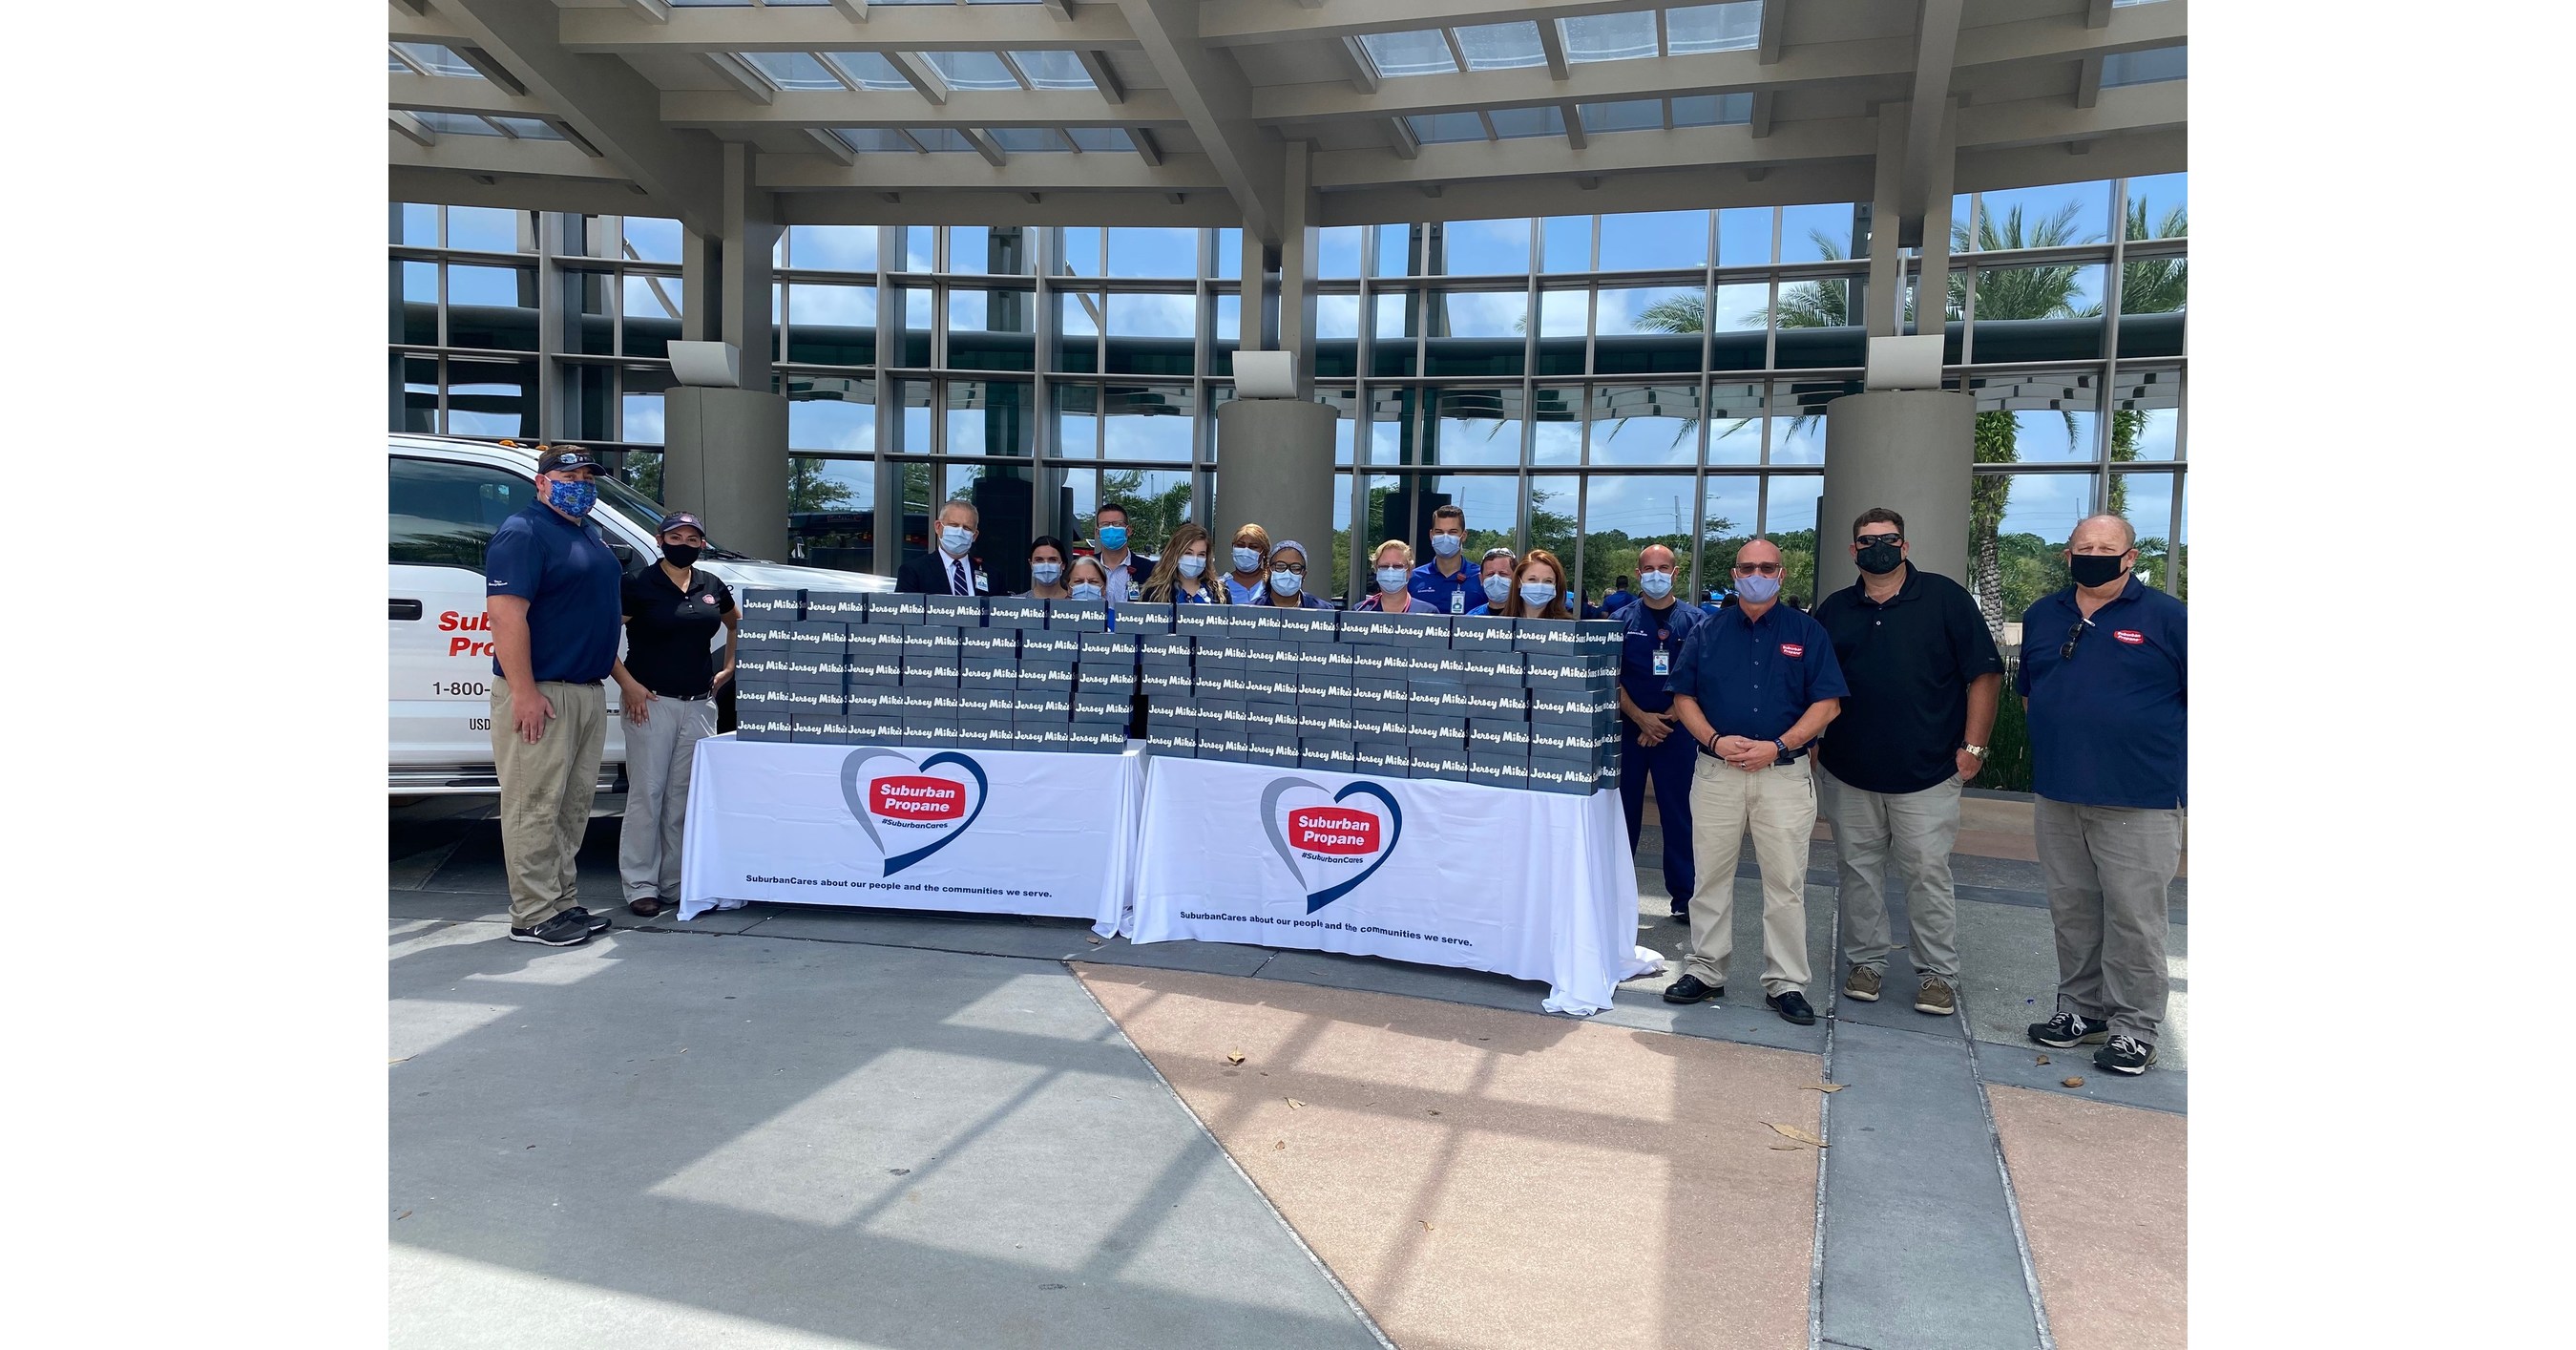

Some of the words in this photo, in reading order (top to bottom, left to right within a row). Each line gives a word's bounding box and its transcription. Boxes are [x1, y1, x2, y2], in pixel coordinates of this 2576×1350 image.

[743, 599, 771, 611] Jersey
[807, 601, 836, 614] Jersey
[869, 603, 898, 615] Jersey
[927, 605, 954, 617] Jersey
[990, 607, 1018, 620] Jersey
[1051, 610, 1079, 622] Jersey
[1115, 613, 1143, 625] Jersey
[1177, 615, 1204, 626] Jersey
[1229, 617, 1256, 629] Jersey
[1282, 619, 1309, 632] Jersey
[1310, 621, 1335, 631] Mike's
[1341, 622, 1369, 635] Jersey
[1394, 624, 1423, 638] Jersey
[1454, 627, 1484, 641] Jersey
[1486, 628, 1513, 640] Mike's
[737, 629, 766, 642] Jersey
[791, 631, 820, 643] Jersey
[848, 633, 876, 645] Jersey
[904, 635, 932, 647] Jersey
[1517, 629, 1546, 643] Jersey
[962, 637, 991, 649] Jersey
[1023, 639, 1053, 651] Jersey
[1081, 643, 1110, 655] Jersey
[1141, 643, 1166, 656] Jersey
[1168, 645, 1190, 655] Mike's
[1197, 646, 1223, 659] Jersey
[1247, 649, 1274, 663] Jersey
[1299, 652, 1327, 665] Jersey
[736, 660, 764, 672] Jersey
[789, 662, 817, 674] Jersey
[819, 663, 844, 673] Mike's
[1353, 655, 1382, 668] Jersey
[1409, 658, 1438, 672] Jersey
[848, 664, 874, 676] Jersey
[875, 664, 900, 675] Mike's
[904, 665, 932, 678] Jersey
[962, 667, 991, 680] Jersey
[1018, 669, 1046, 682] Jersey
[1464, 662, 1494, 676] Jersey
[1497, 664, 1523, 675] Mike's
[1527, 664, 1559, 679] Jersey
[1560, 666, 1587, 678] Mike's
[1079, 673, 1108, 686] Jersey
[1142, 674, 1167, 686] Jersey
[1169, 676, 1192, 686] Mike's
[1196, 677, 1222, 690] Jersey
[1246, 681, 1272, 694] Jersey
[1273, 683, 1297, 693] Mike's
[1299, 684, 1326, 697] Jersey
[1353, 687, 1381, 701] Jersey
[736, 690, 765, 703] Jersey
[789, 692, 817, 706] Jersey
[819, 694, 844, 704] Mike's
[848, 694, 877, 707] Jersey
[904, 696, 932, 708] Jersey
[1410, 692, 1440, 706] Jersey
[1468, 695, 1497, 709] Jersey
[1498, 698, 1526, 709] Mike's
[958, 698, 987, 710] Jersey
[1015, 700, 1043, 712] Jersey
[1076, 703, 1104, 715] Jersey
[1533, 700, 1564, 714] Jersey
[1148, 705, 1173, 717] Jersey
[1175, 707, 1197, 716] Mike's
[1197, 707, 1223, 721] Jersey
[1224, 710, 1246, 721] Mike's
[1247, 712, 1273, 726] Jersey
[1299, 716, 1327, 729] Jersey
[1328, 718, 1351, 728] Mike's
[738, 721, 765, 732] Jersey
[793, 723, 822, 735] Jersey
[848, 725, 876, 737] Jersey
[903, 727, 932, 739] Jersey
[1352, 720, 1380, 734] Jersey
[1408, 725, 1437, 739] Jersey
[959, 728, 988, 741] Jersey
[1015, 730, 1043, 743] Jersey
[1070, 732, 1099, 745] Jersey
[1471, 729, 1500, 744] Jersey
[1147, 735, 1172, 748] Jersey
[1173, 737, 1196, 747] Mike's
[1199, 739, 1224, 751] Jersey
[1225, 741, 1247, 751] Mike's
[1532, 734, 1563, 749] Jersey
[1248, 743, 1274, 756] Jersey
[1275, 746, 1299, 756] Mike's
[1302, 748, 1329, 762] Jersey
[1330, 750, 1354, 761] Mike's
[1356, 752, 1383, 767] Jersey
[1385, 755, 1409, 766] Mike's
[1411, 757, 1440, 771] Jersey
[1442, 760, 1468, 771] Mike's
[1469, 762, 1500, 777] Jersey
[1530, 768, 1562, 783] Jersey
[1564, 770, 1592, 783] Mike's
[880, 784, 954, 798] Suburban
[885, 798, 950, 812] Propane
[882, 818, 948, 829] #SuburbanCares
[1299, 815, 1370, 831] Suburban
[1304, 831, 1364, 846] Propane
[1302, 853, 1363, 863] #SuburbanCares
[746, 875, 818, 885] SuburbanCares
[869, 882, 901, 891] people
[1181, 912, 1246, 921] SuburbanCares
[1249, 916, 1274, 924] about
[1293, 919, 1323, 928] people
[1345, 923, 1357, 932] the
[1360, 927, 1421, 939] communities
[1441, 937, 1473, 946] serve.
